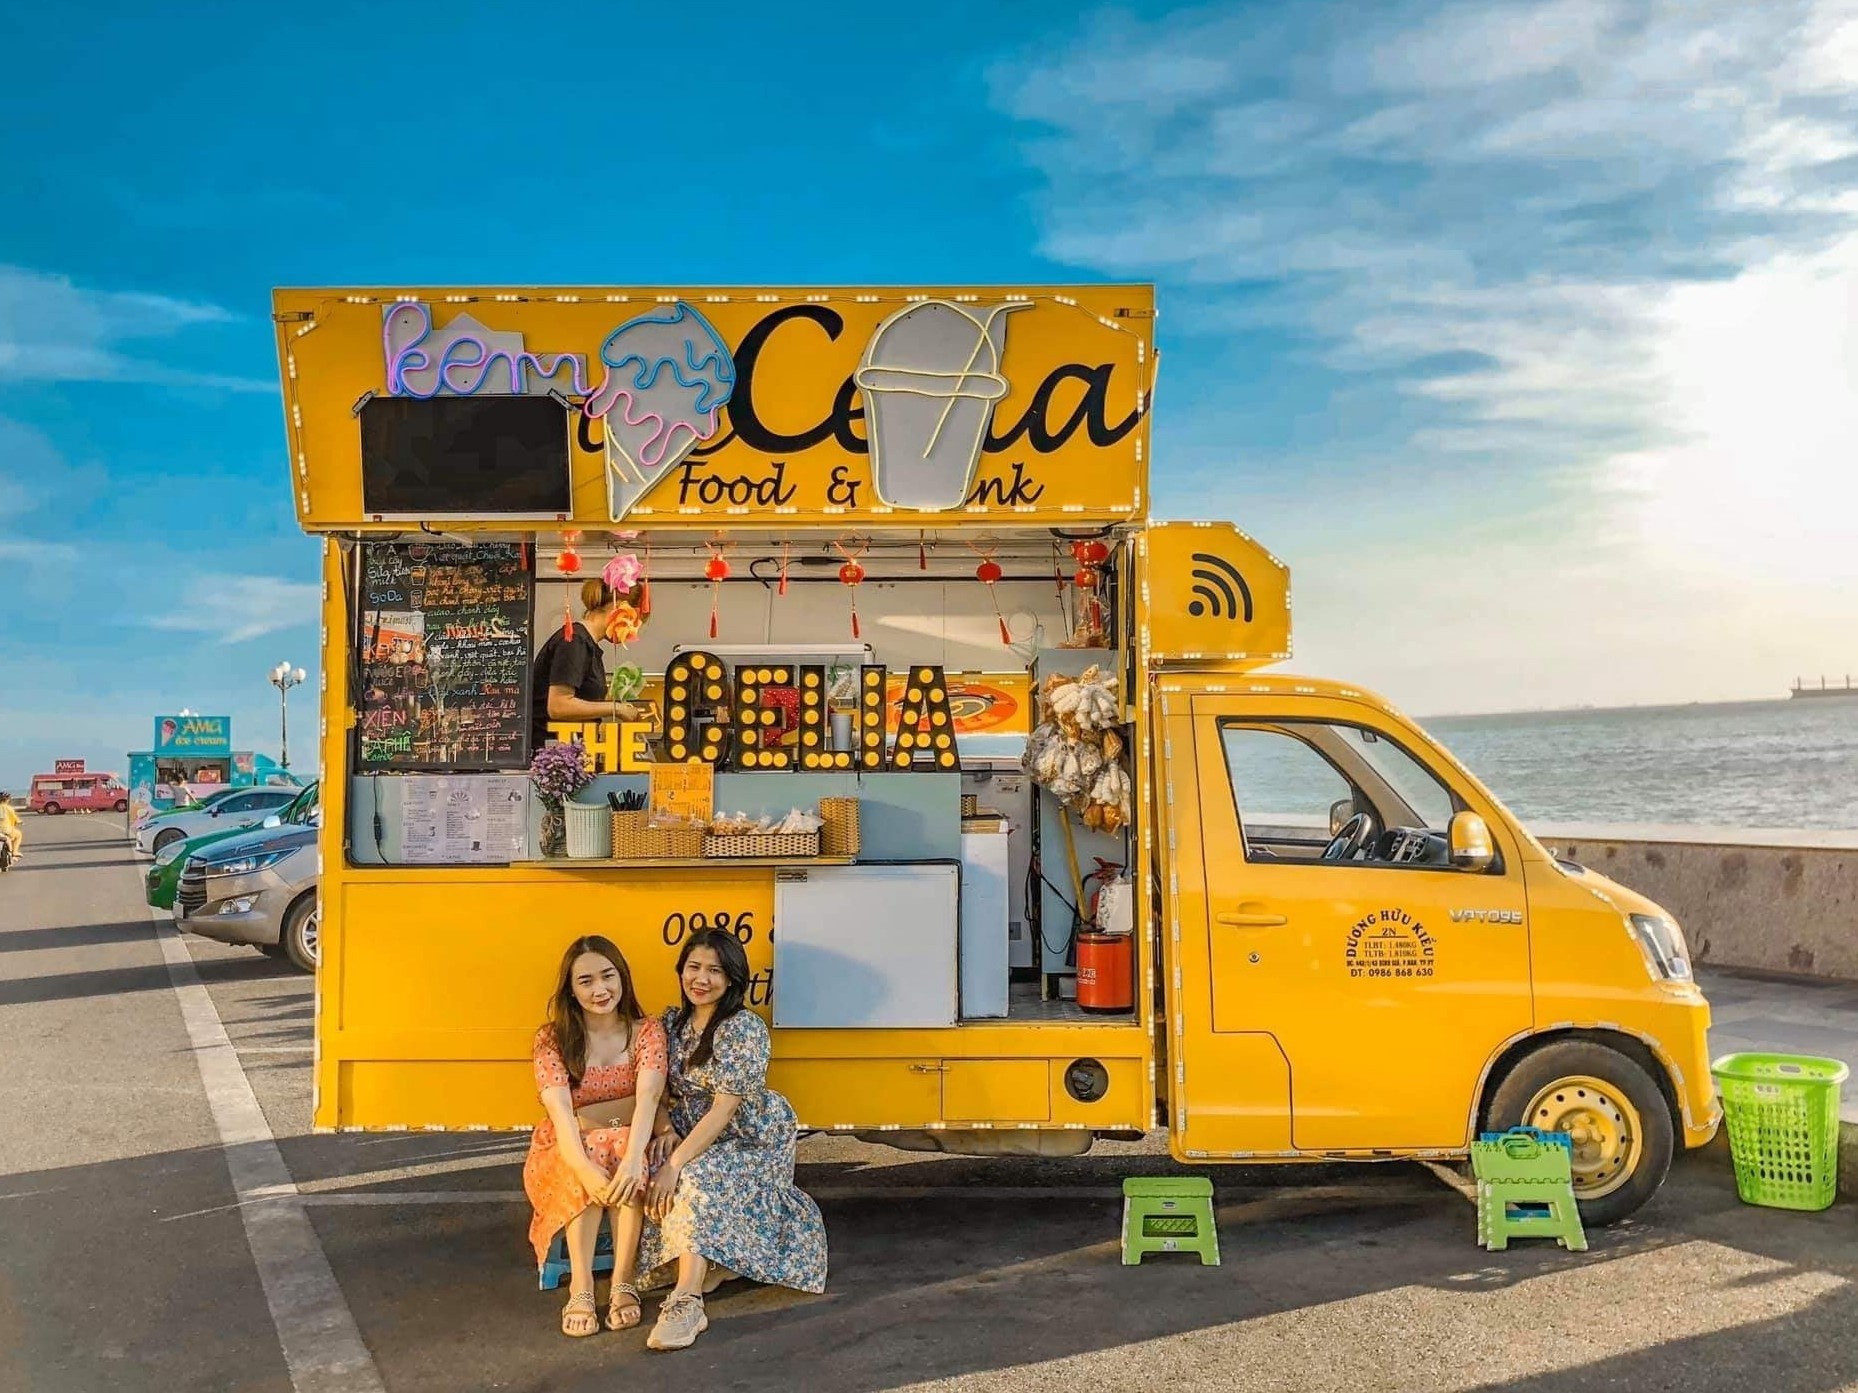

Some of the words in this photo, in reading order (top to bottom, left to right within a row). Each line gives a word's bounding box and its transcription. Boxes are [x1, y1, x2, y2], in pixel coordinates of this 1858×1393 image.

[679, 460, 797, 506] Food
[827, 465, 863, 509] &
[545, 721, 654, 772] THE
[663, 651, 961, 773] CELIA
[1368, 969, 1392, 977] 0986
[1395, 969, 1413, 977] 868
[1416, 968, 1434, 977] 630
